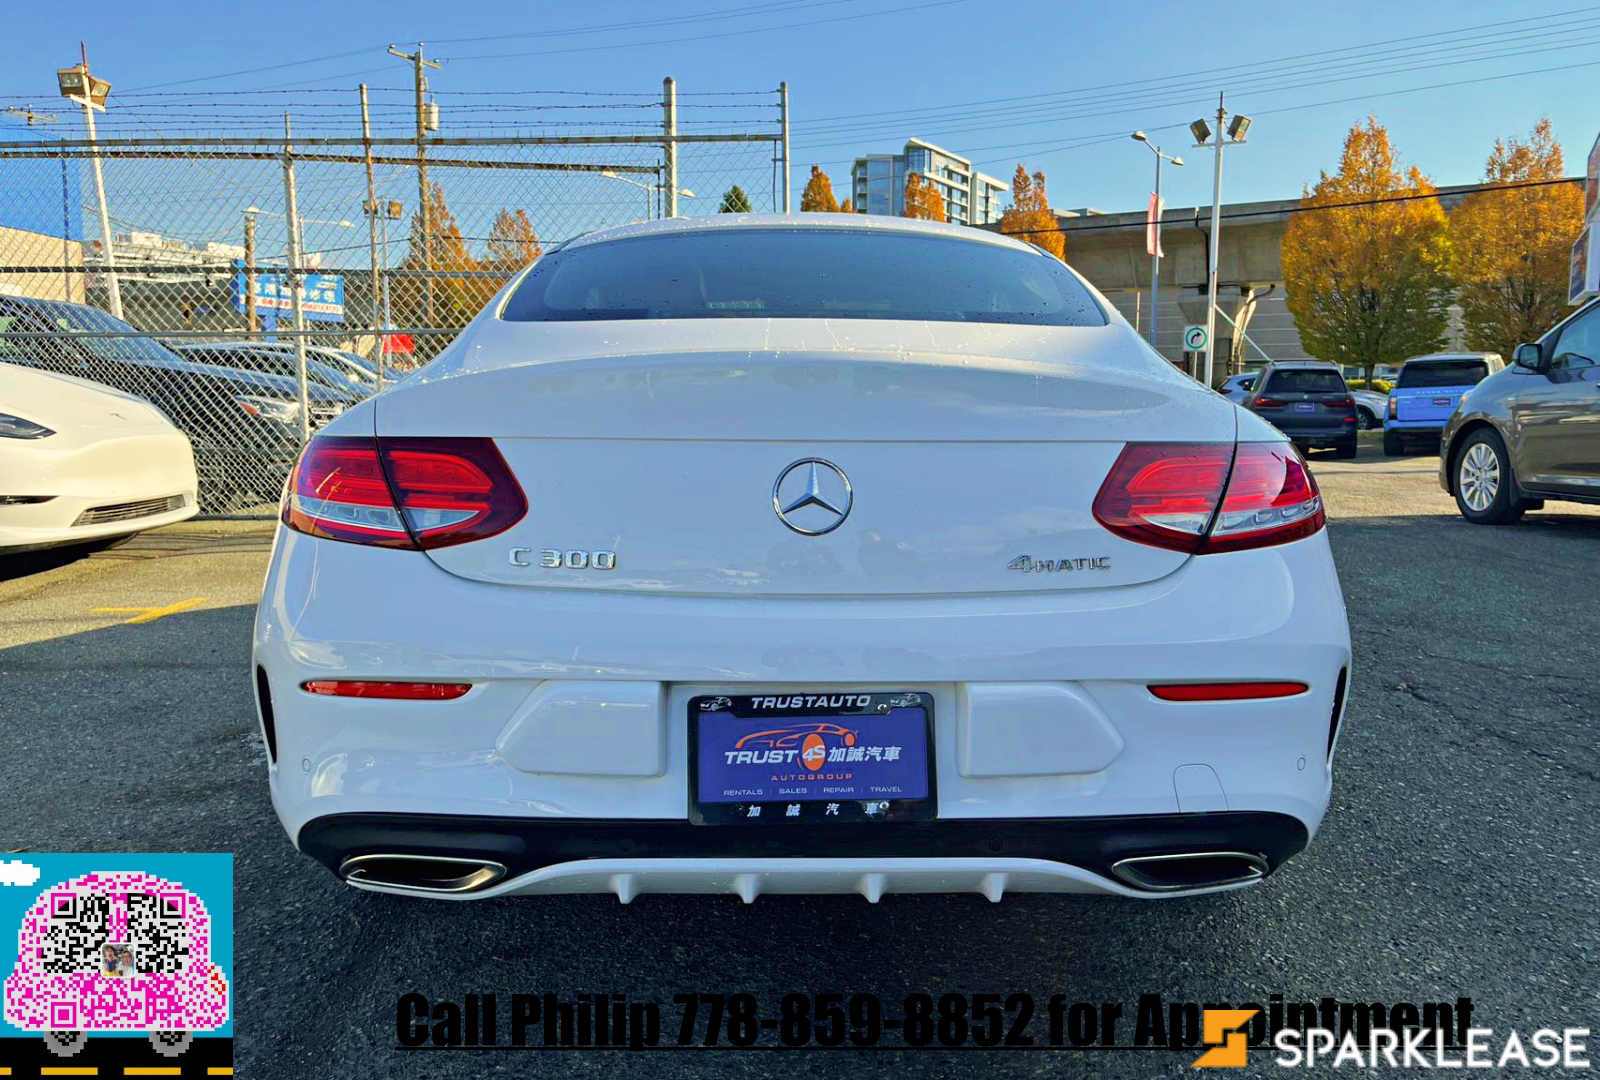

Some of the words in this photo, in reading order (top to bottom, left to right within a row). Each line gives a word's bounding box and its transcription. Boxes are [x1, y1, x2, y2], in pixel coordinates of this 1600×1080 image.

[508, 547, 531, 567] C
[540, 548, 616, 570] 300
[1007, 554, 1111, 573] 4MATIC
[751, 694, 872, 710] TRUSTAUTO
[724, 749, 799, 765] TRUST
[802, 744, 826, 762] 4S
[827, 745, 902, 763] 加誠汽車
[771, 772, 854, 782] AUTOGROUP
[723, 788, 764, 797] RENTALS
[778, 787, 808, 795] SALES
[823, 786, 855, 794] REPAIR
[869, 785, 902, 793] TRAVEL
